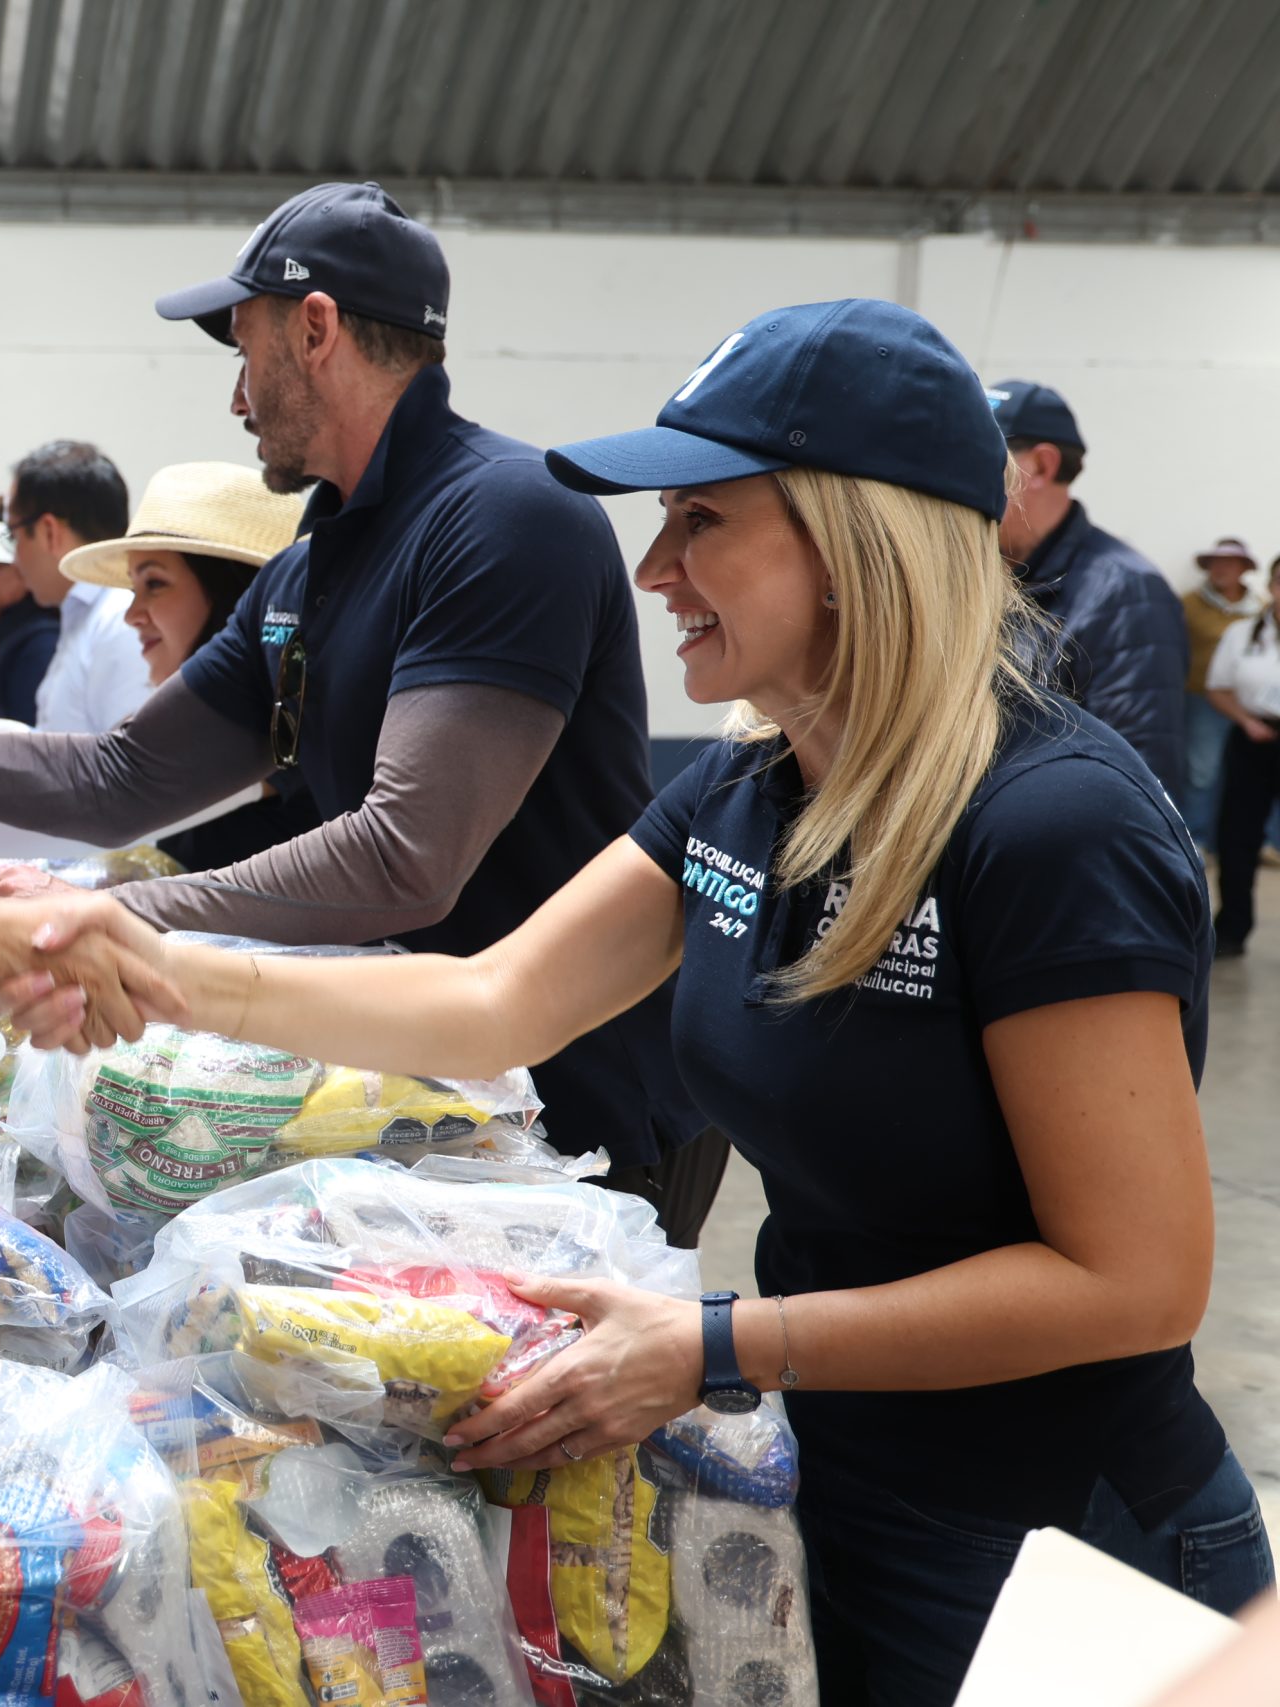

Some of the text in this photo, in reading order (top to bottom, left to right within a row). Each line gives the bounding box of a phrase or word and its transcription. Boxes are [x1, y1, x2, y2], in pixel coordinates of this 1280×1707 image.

[709, 912, 748, 938] 24/7
[877, 957, 936, 978] unicipal
[115, 1106, 141, 1121] SUPER
[140, 1148, 203, 1179] FRESNO
[217, 1161, 235, 1174] EL
[153, 1174, 213, 1189] EMPACADORA
[292, 1324, 318, 1343] 100
